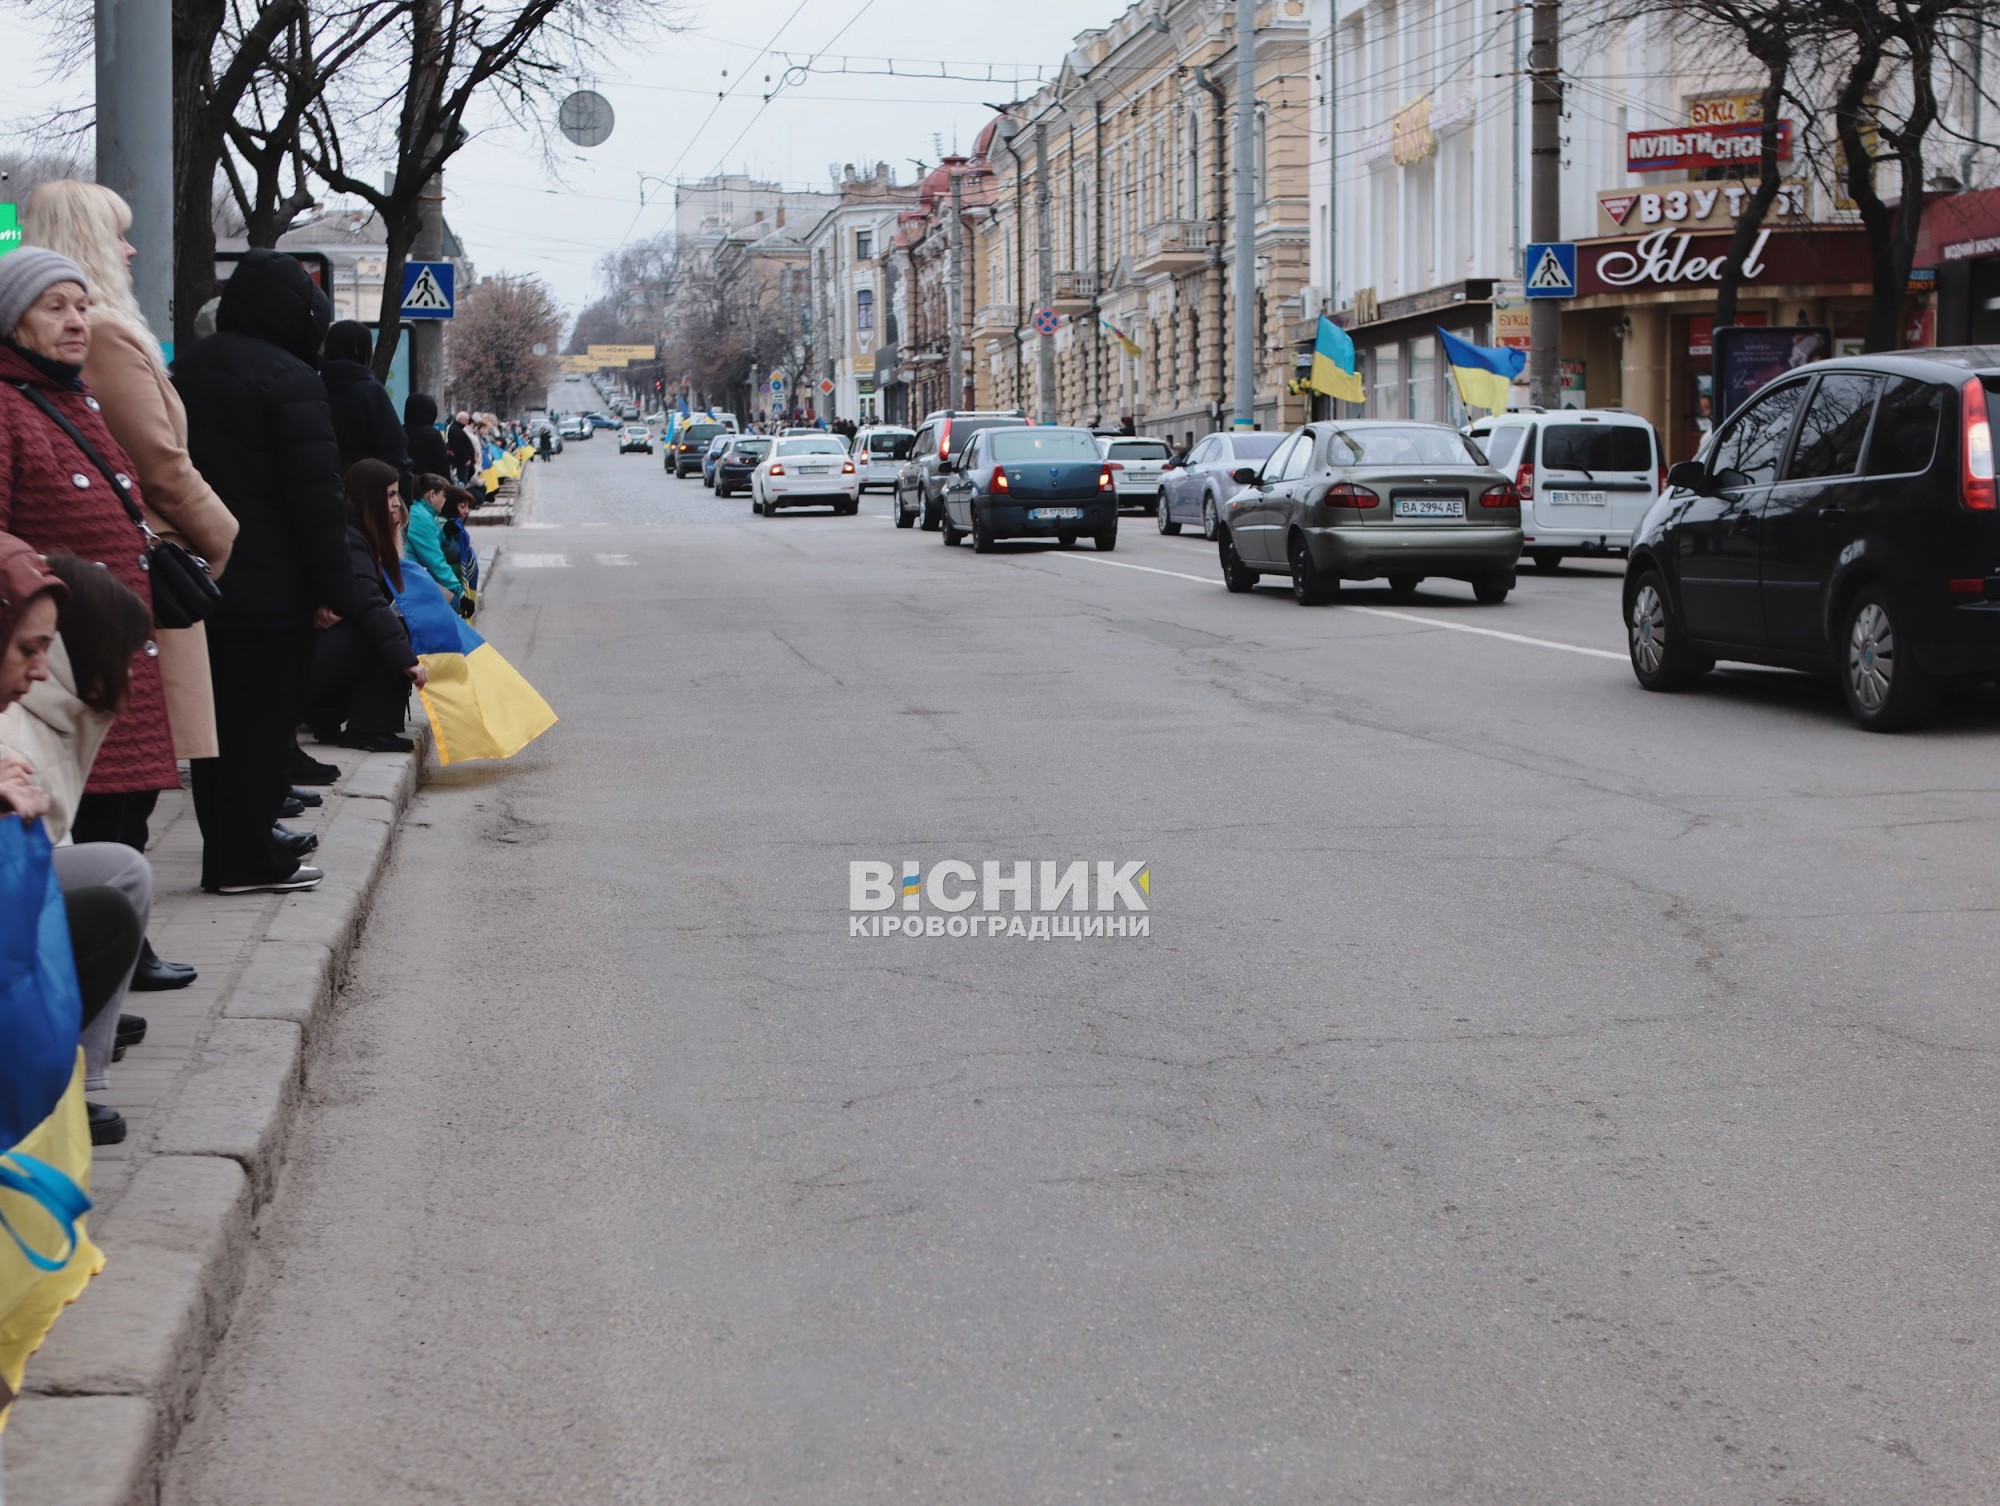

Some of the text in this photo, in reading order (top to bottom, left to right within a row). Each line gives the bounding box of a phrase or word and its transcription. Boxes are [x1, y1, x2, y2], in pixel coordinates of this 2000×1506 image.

[1640, 184, 1805, 224] ВЗУТЯ
[1571, 493, 1589, 503] 7635
[1402, 502, 1460, 513] BA 2994 AE
